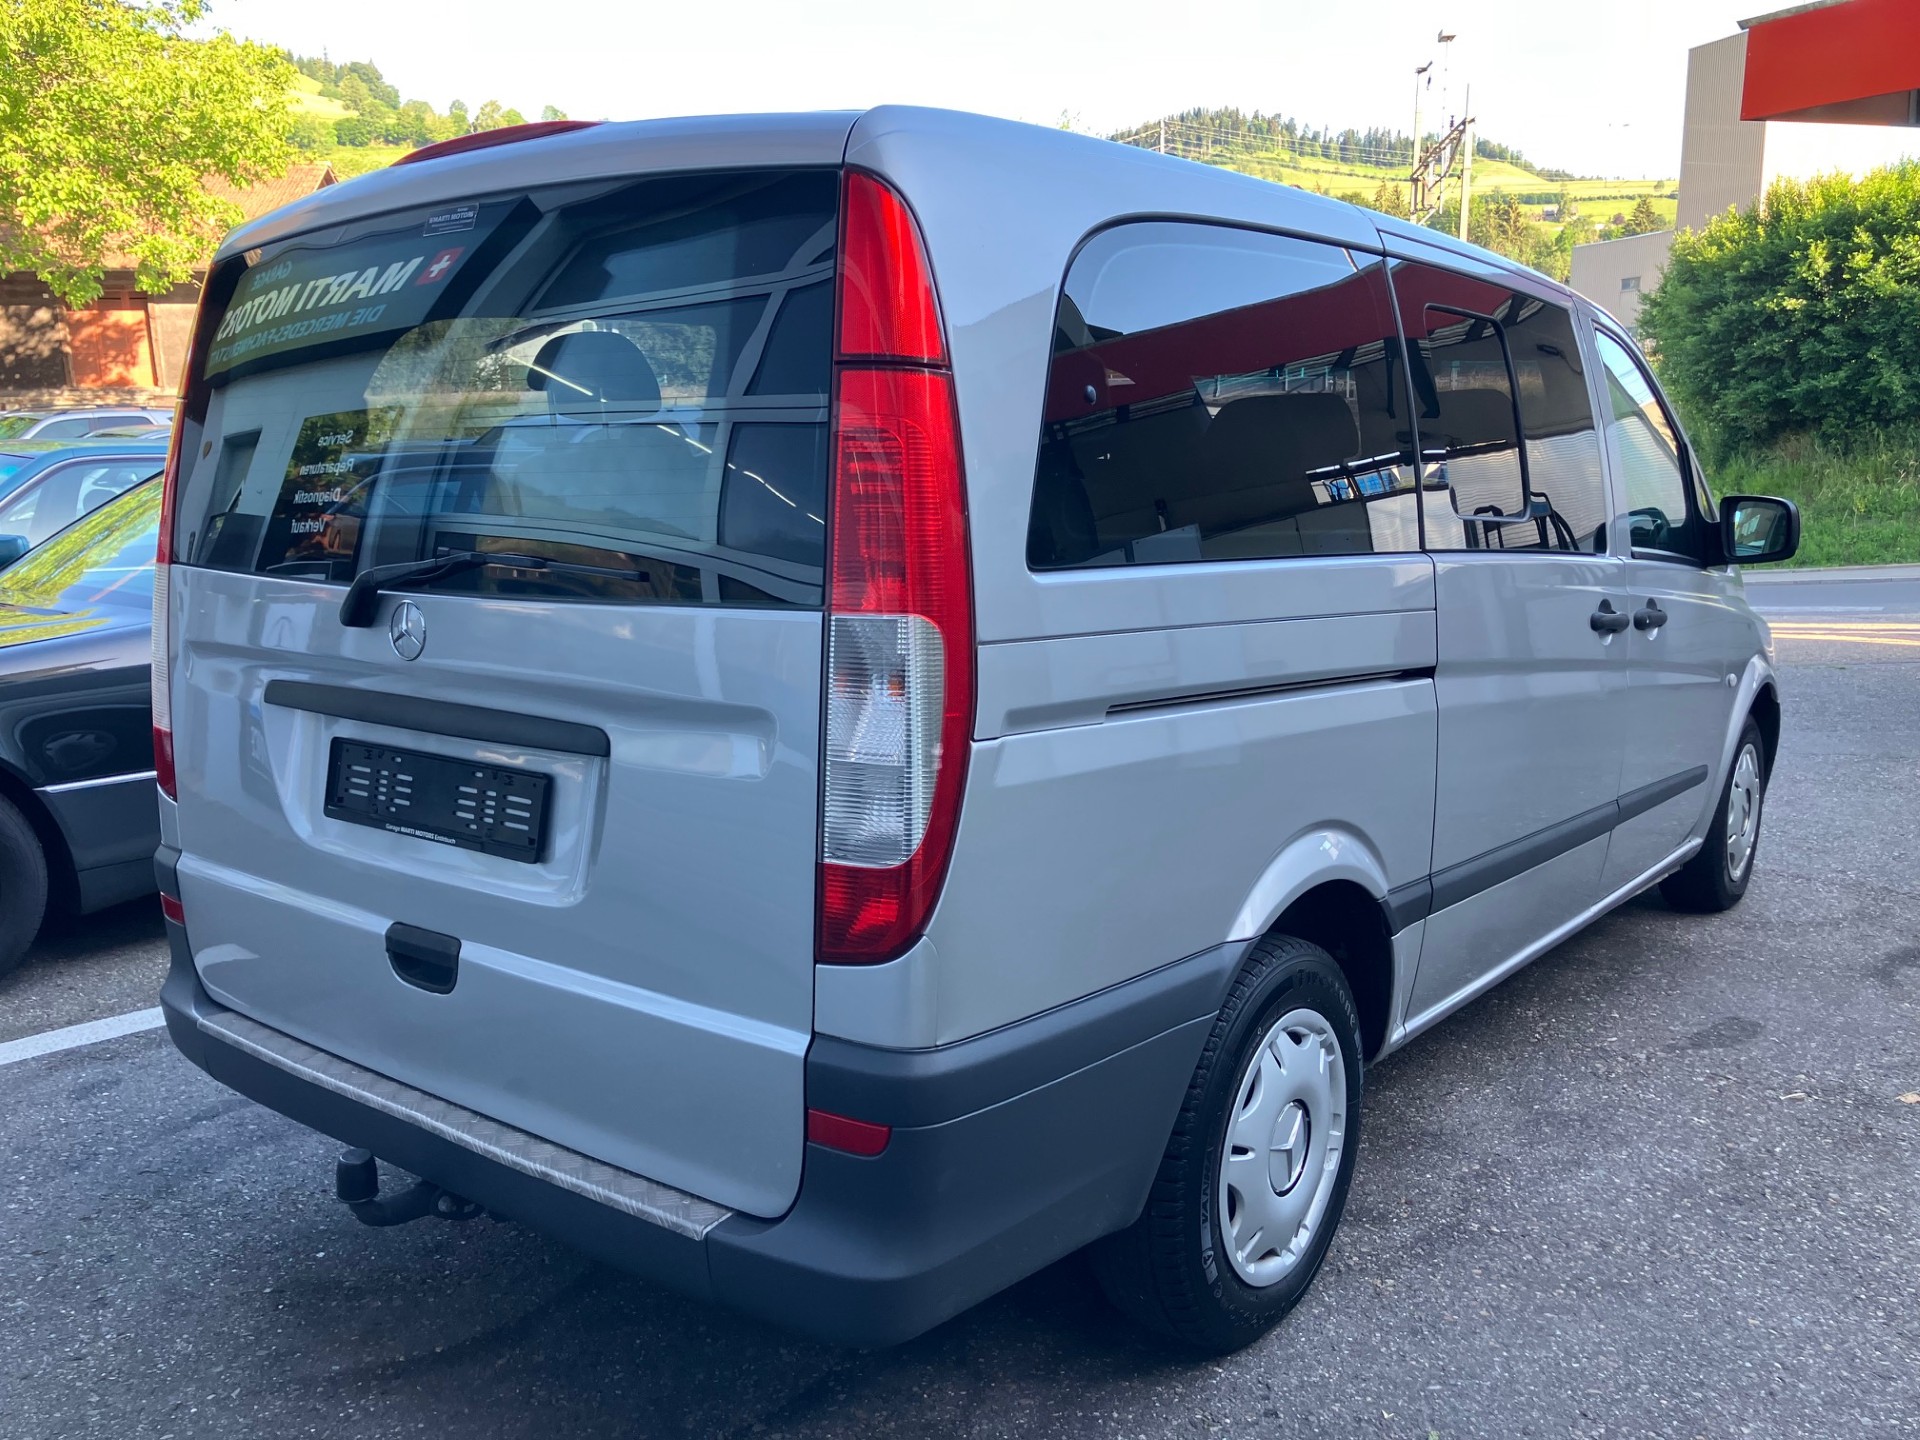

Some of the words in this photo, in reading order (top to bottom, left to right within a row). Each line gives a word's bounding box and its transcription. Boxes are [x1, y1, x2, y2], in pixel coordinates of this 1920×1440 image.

[386, 823, 401, 832] Garage
[401, 826, 415, 834] MARTI
[415, 829, 434, 839] MOTORS
